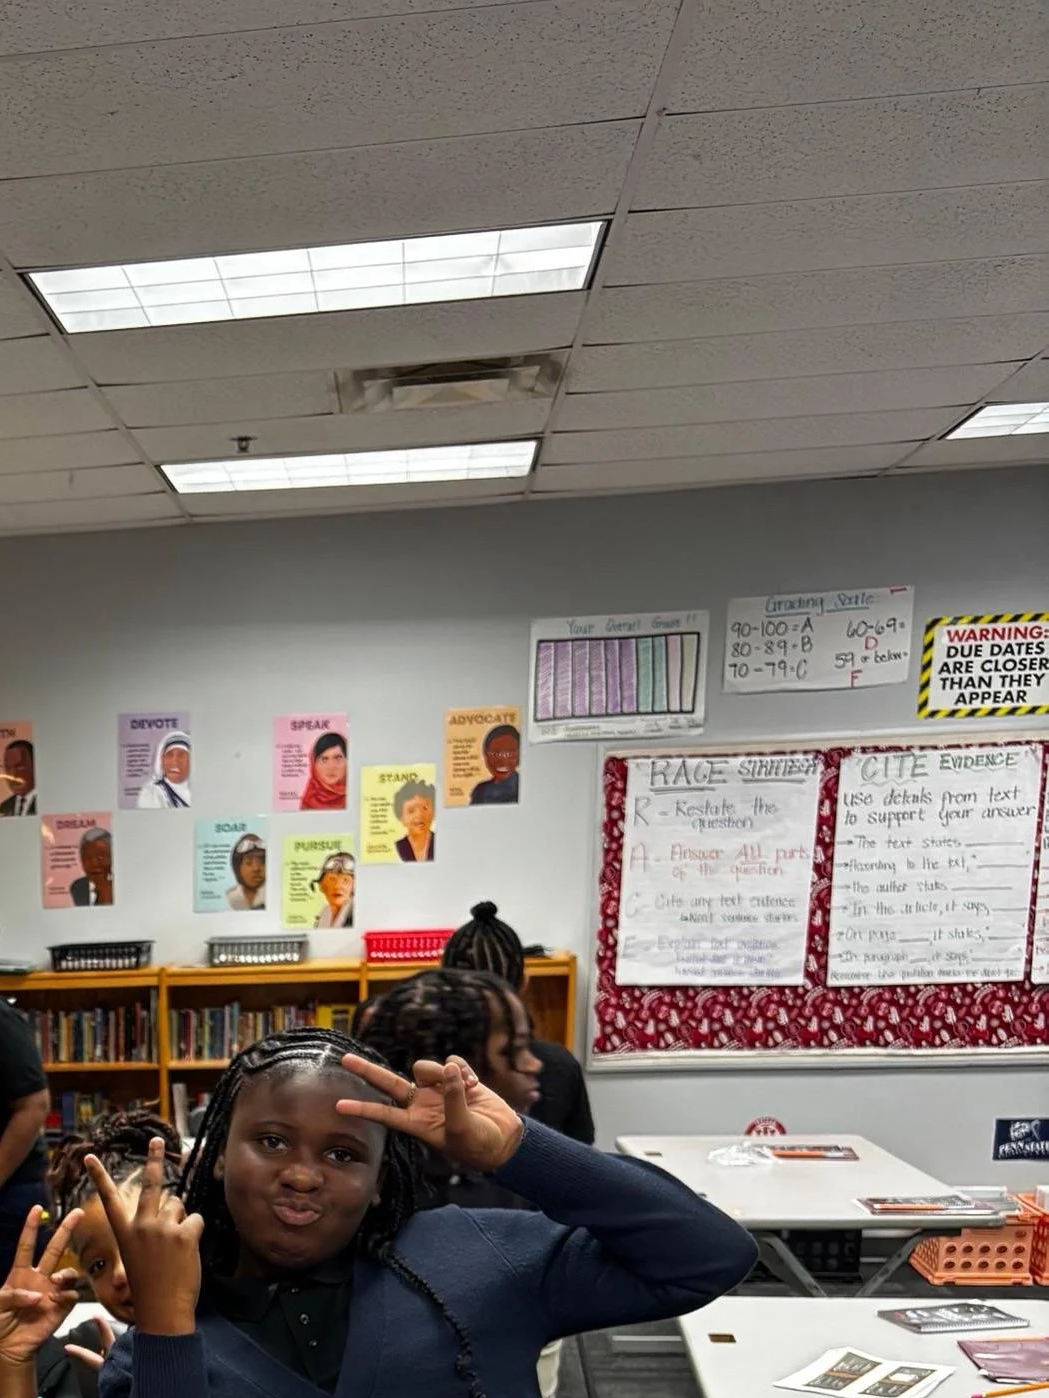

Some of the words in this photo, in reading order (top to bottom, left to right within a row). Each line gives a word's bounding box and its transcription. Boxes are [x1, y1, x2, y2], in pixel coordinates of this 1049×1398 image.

[946, 625, 1049, 643] WARNING:
[864, 635, 879, 651] D
[946, 644, 983, 659] DUE
[990, 641, 1045, 657] DATES
[938, 660, 974, 675] ARE
[980, 657, 1049, 673] CLOSER
[850, 669, 863, 689] F
[940, 675, 992, 691] THAN
[999, 673, 1046, 688] THEY
[954, 690, 1027, 705] APPEAR
[129, 718, 179, 730] DEVOTE
[289, 719, 331, 732] SPEAK
[448, 712, 516, 726] ADVOCATE
[650, 759, 729, 786] RACE
[859, 753, 929, 782] CITE
[938, 752, 1020, 771] EVIDENCE
[378, 772, 419, 784] STAND
[941, 789, 978, 811] from
[56, 819, 97, 830] DREAM
[867, 807, 924, 829] support
[215, 823, 247, 834] SOAR
[293, 840, 343, 851] PURSUE
